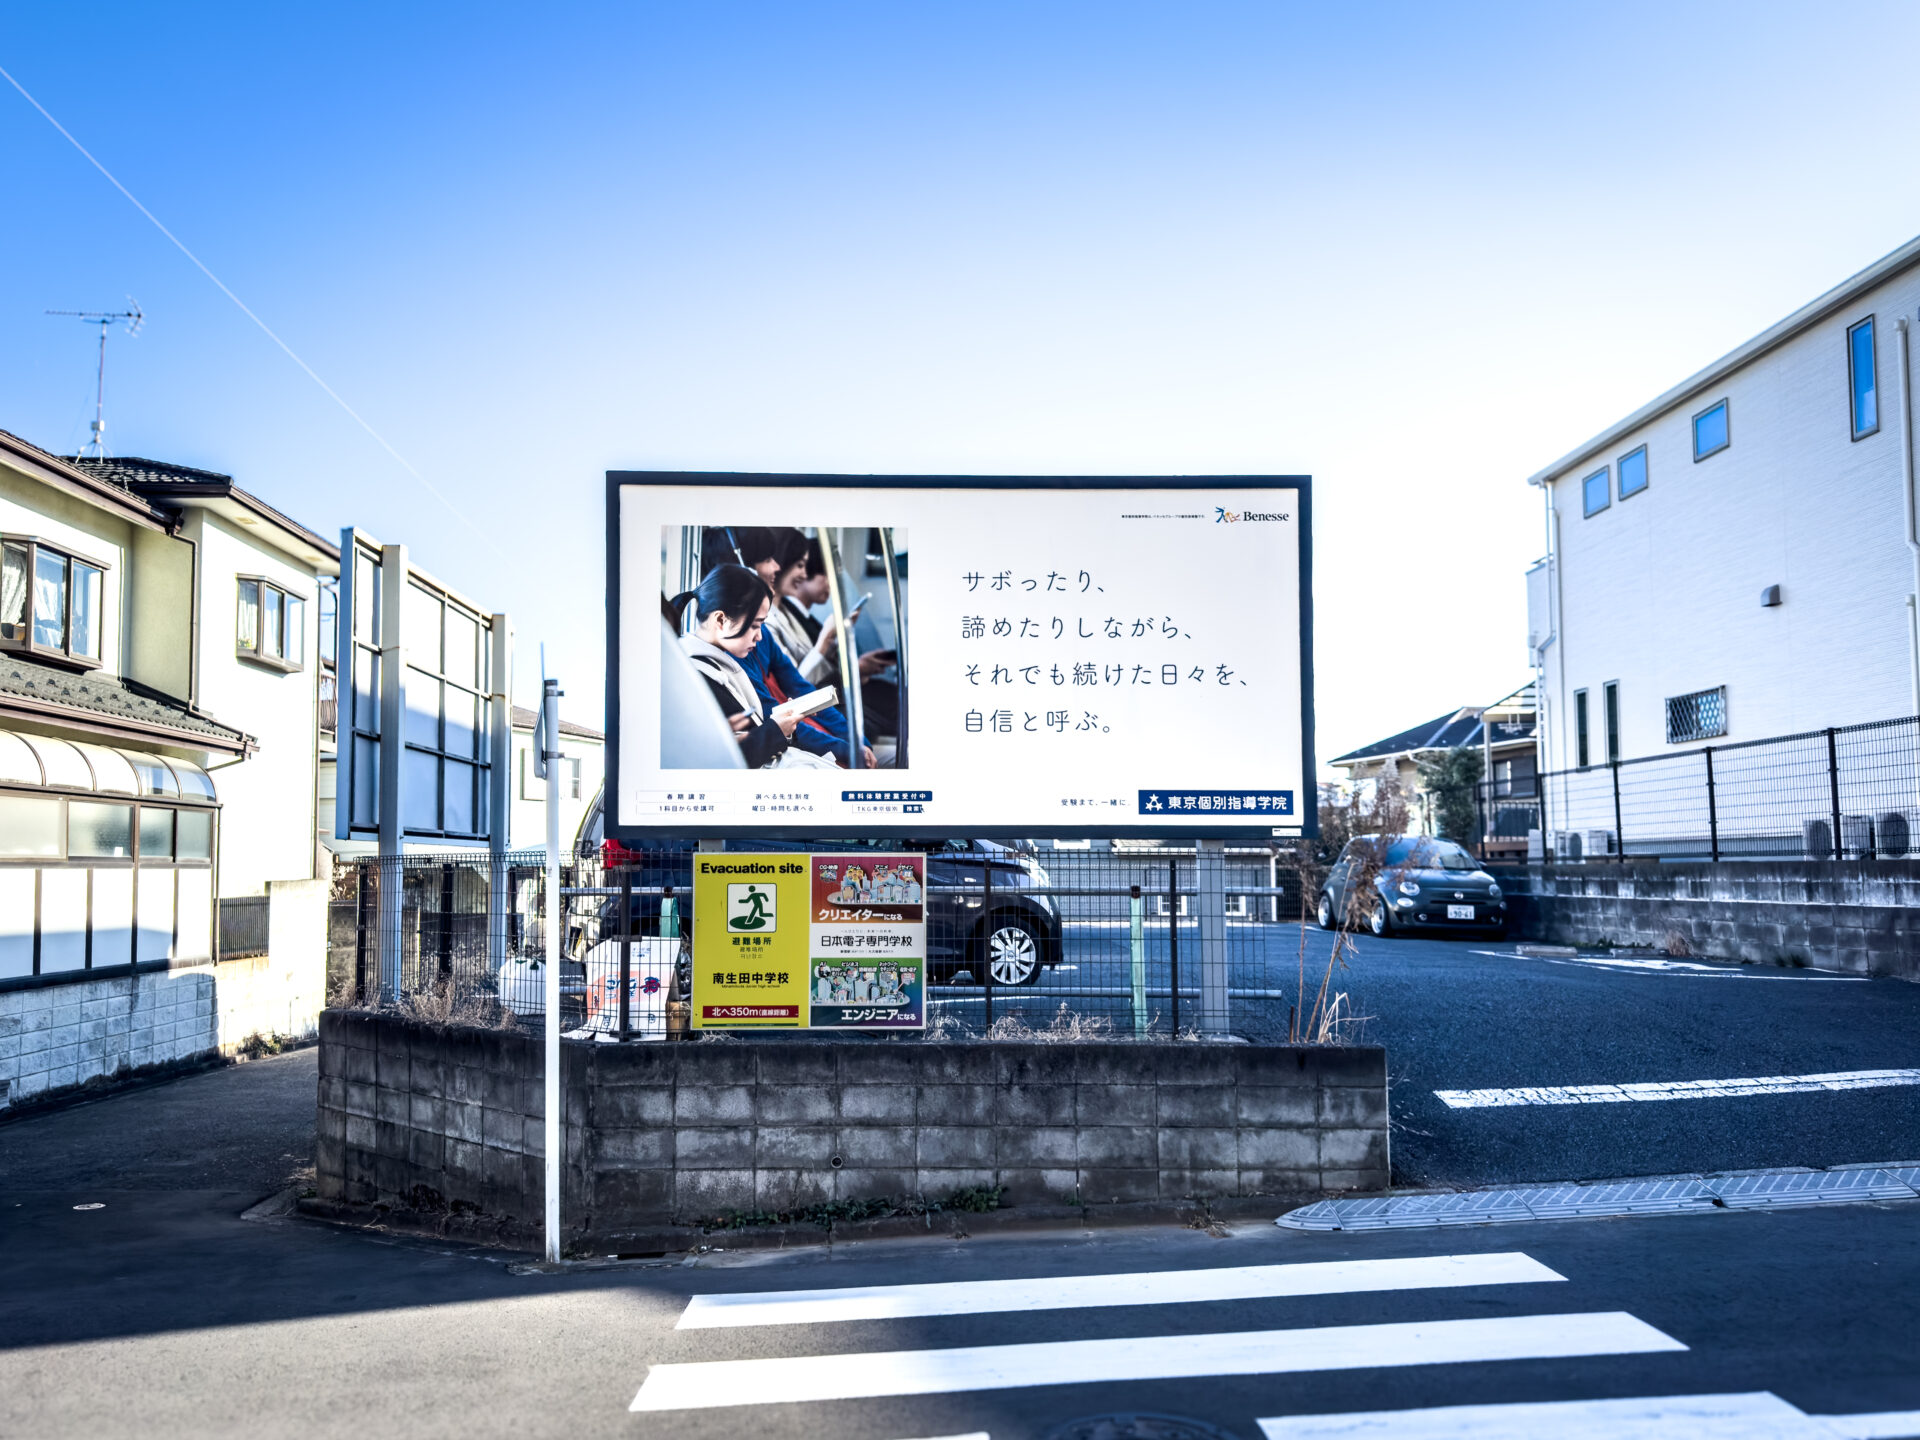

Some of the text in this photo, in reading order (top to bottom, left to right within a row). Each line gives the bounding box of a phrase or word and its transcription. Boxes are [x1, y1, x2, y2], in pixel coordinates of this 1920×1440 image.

[1243, 511, 1289, 522] Benesse
[962, 569, 1104, 592] サボったり、
[961, 615, 1191, 640] 諦めたりしながら、
[964, 661, 1247, 686] それでも続けた日々を、
[965, 708, 1110, 733] 自信と呼ぶ。
[1168, 796, 1288, 810] 東京個別指導学院
[701, 863, 803, 874] Evacuation site
[818, 908, 903, 921] クリエイターになる
[732, 937, 772, 946] 避難場所
[821, 935, 913, 947] 日本電子専門学校
[712, 972, 789, 984] 南生田中学校
[840, 1009, 917, 1021] エンジニアになる
